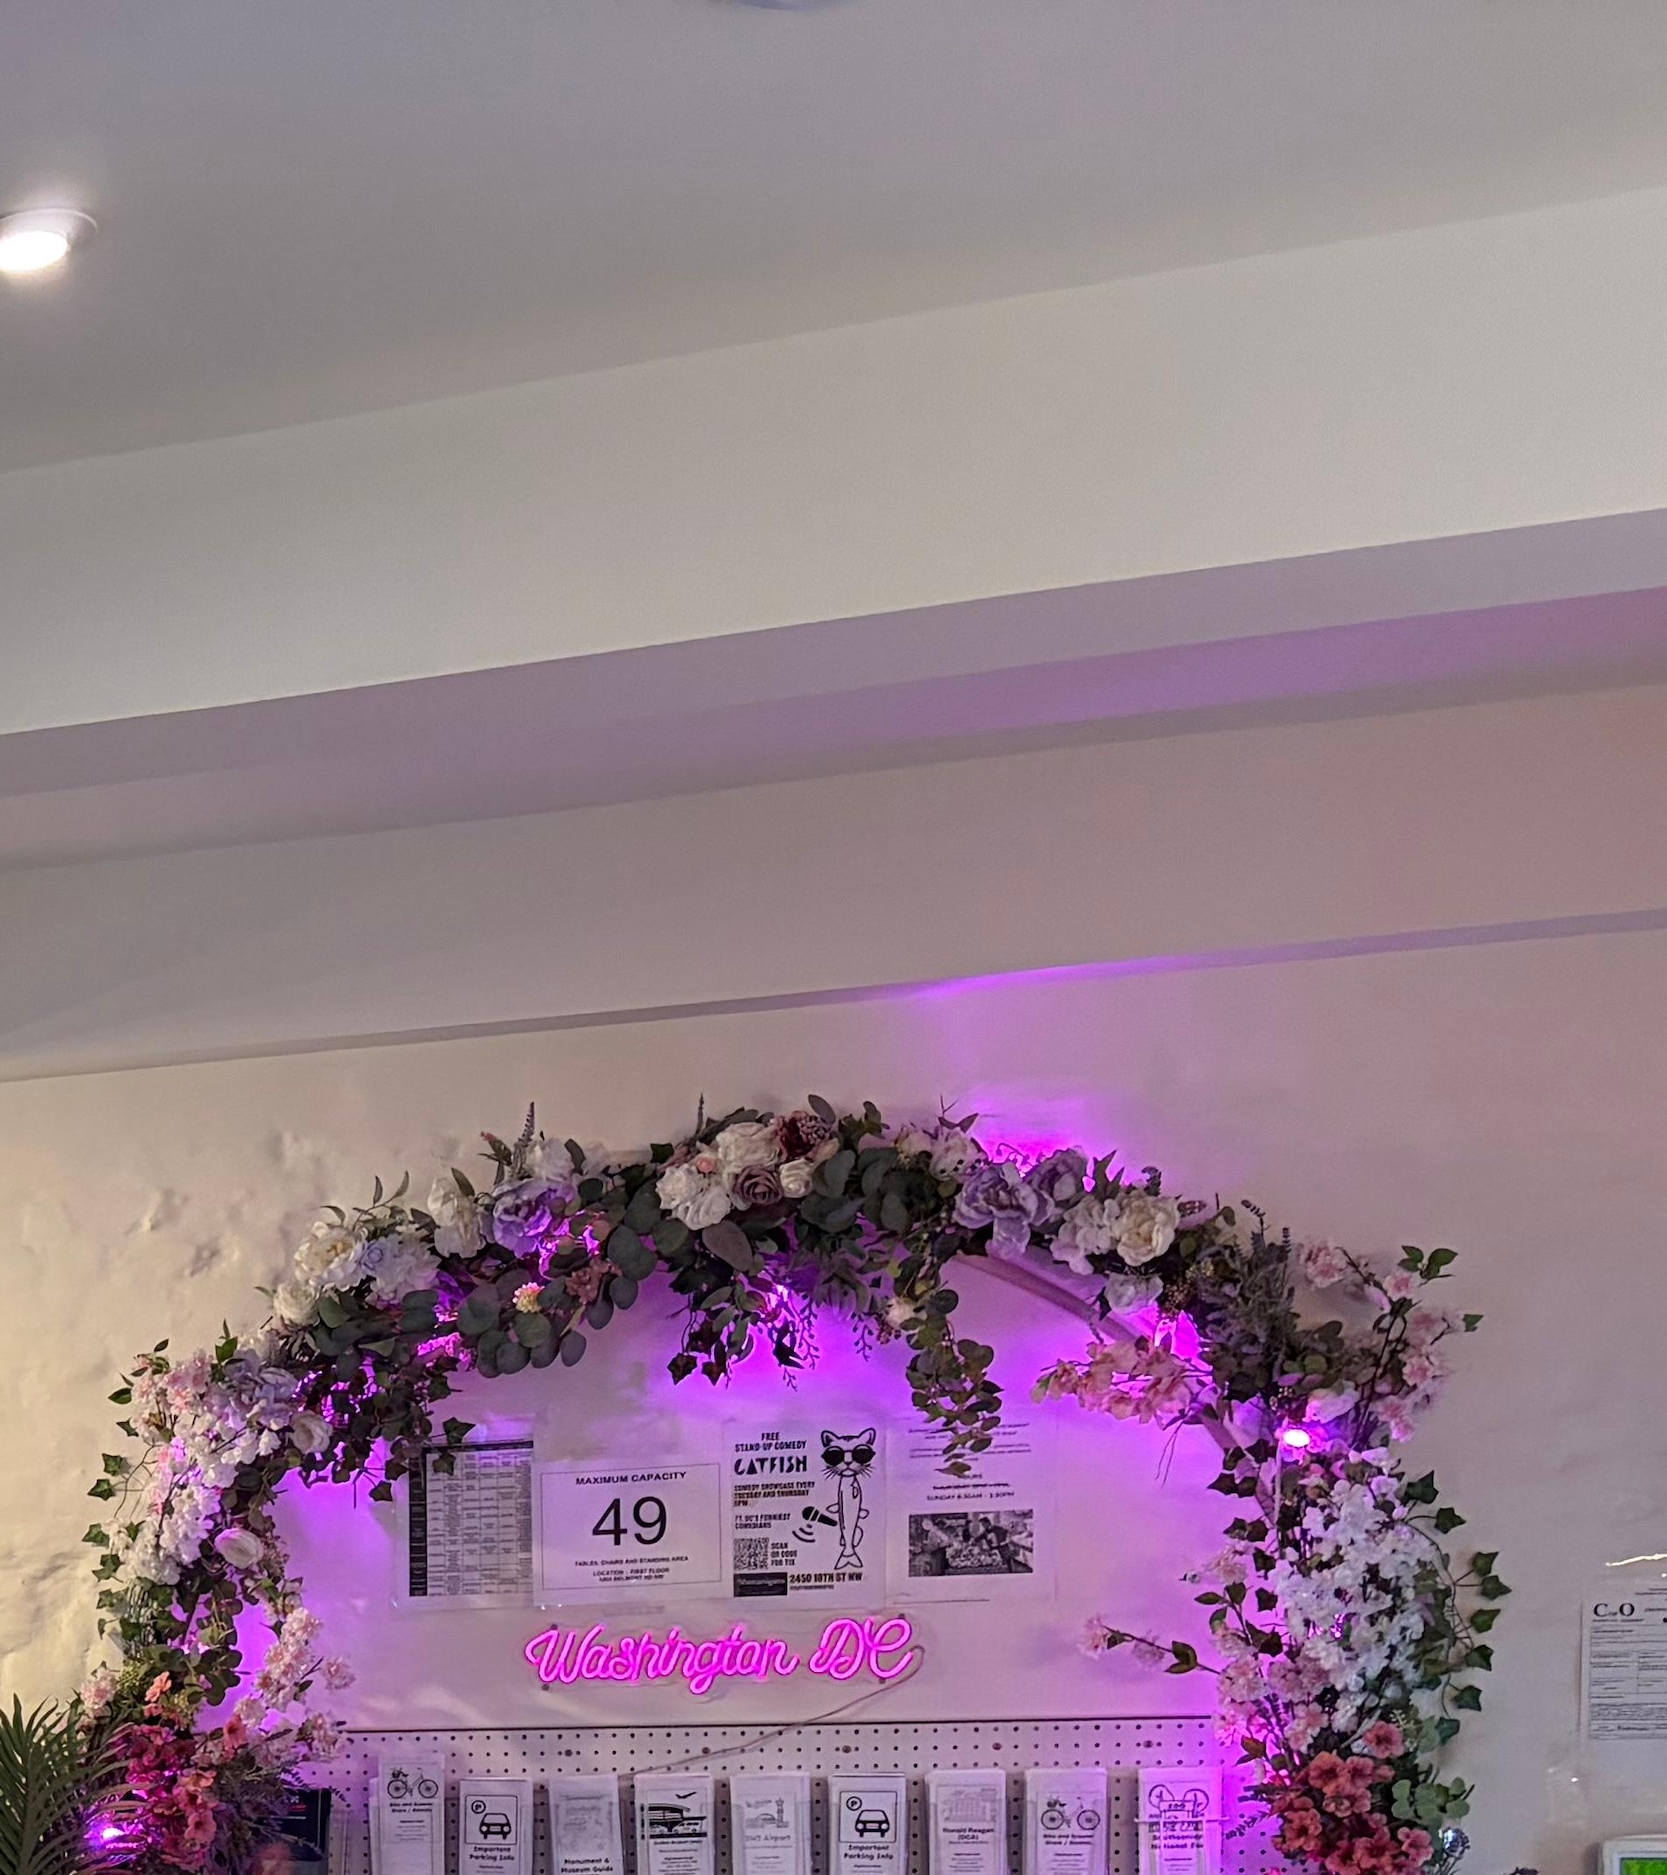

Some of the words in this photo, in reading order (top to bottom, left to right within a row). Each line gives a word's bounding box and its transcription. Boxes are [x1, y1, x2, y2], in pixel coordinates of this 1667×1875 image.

[761, 1432, 779, 1441] FREE
[735, 1442, 773, 1452] STAND-UP
[775, 1441, 807, 1450] COMEDY
[734, 1456, 807, 1475] CATFISH
[576, 1475, 628, 1485] MAXIMUM
[631, 1472, 686, 1482] CAPACITY
[592, 1496, 667, 1546] 49
[789, 1574, 812, 1583] 2450
[836, 1573, 846, 1582] ST
[848, 1572, 862, 1581] NW
[525, 1623, 802, 1695] Washington
[810, 1617, 913, 1680] DC
[469, 1853, 498, 1862] Parking
[499, 1854, 515, 1862] Info
[844, 1853, 875, 1861] Parking
[876, 1853, 894, 1861] Info
[561, 1865, 591, 1874] Museum
[593, 1865, 614, 1873] Guide
